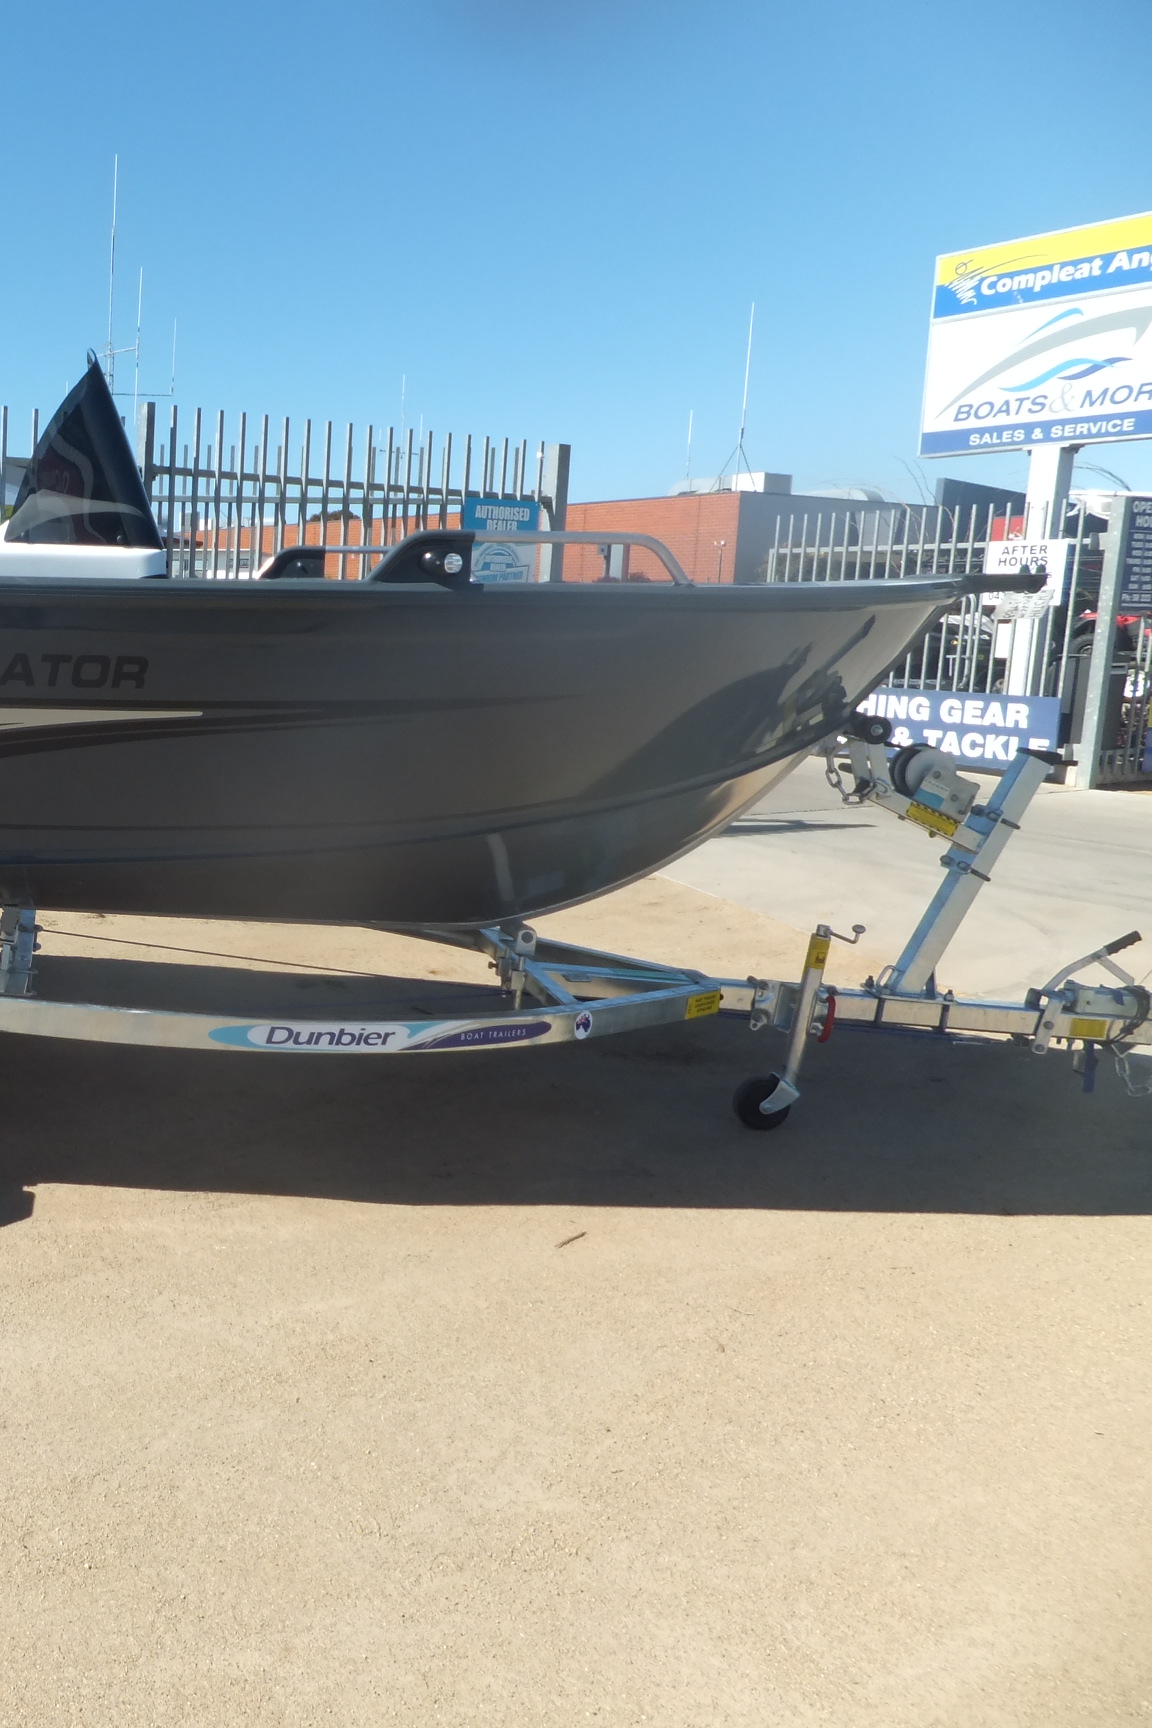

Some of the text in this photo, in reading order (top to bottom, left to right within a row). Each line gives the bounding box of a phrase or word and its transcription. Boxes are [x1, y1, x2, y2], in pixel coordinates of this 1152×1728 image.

[981, 250, 1152, 296] Compleat An
[953, 395, 1048, 422] BOATS
[969, 418, 1135, 445] SALES & SERVICE
[475, 505, 530, 521] AUTHORISED
[1001, 545, 1048, 555] AFTER
[998, 556, 1048, 567] HOURS
[939, 698, 1029, 728] GEAR
[891, 727, 913, 750] &
[265, 1025, 396, 1047] Dunbier
[460, 1029, 527, 1040] BOAT TRAILERS
